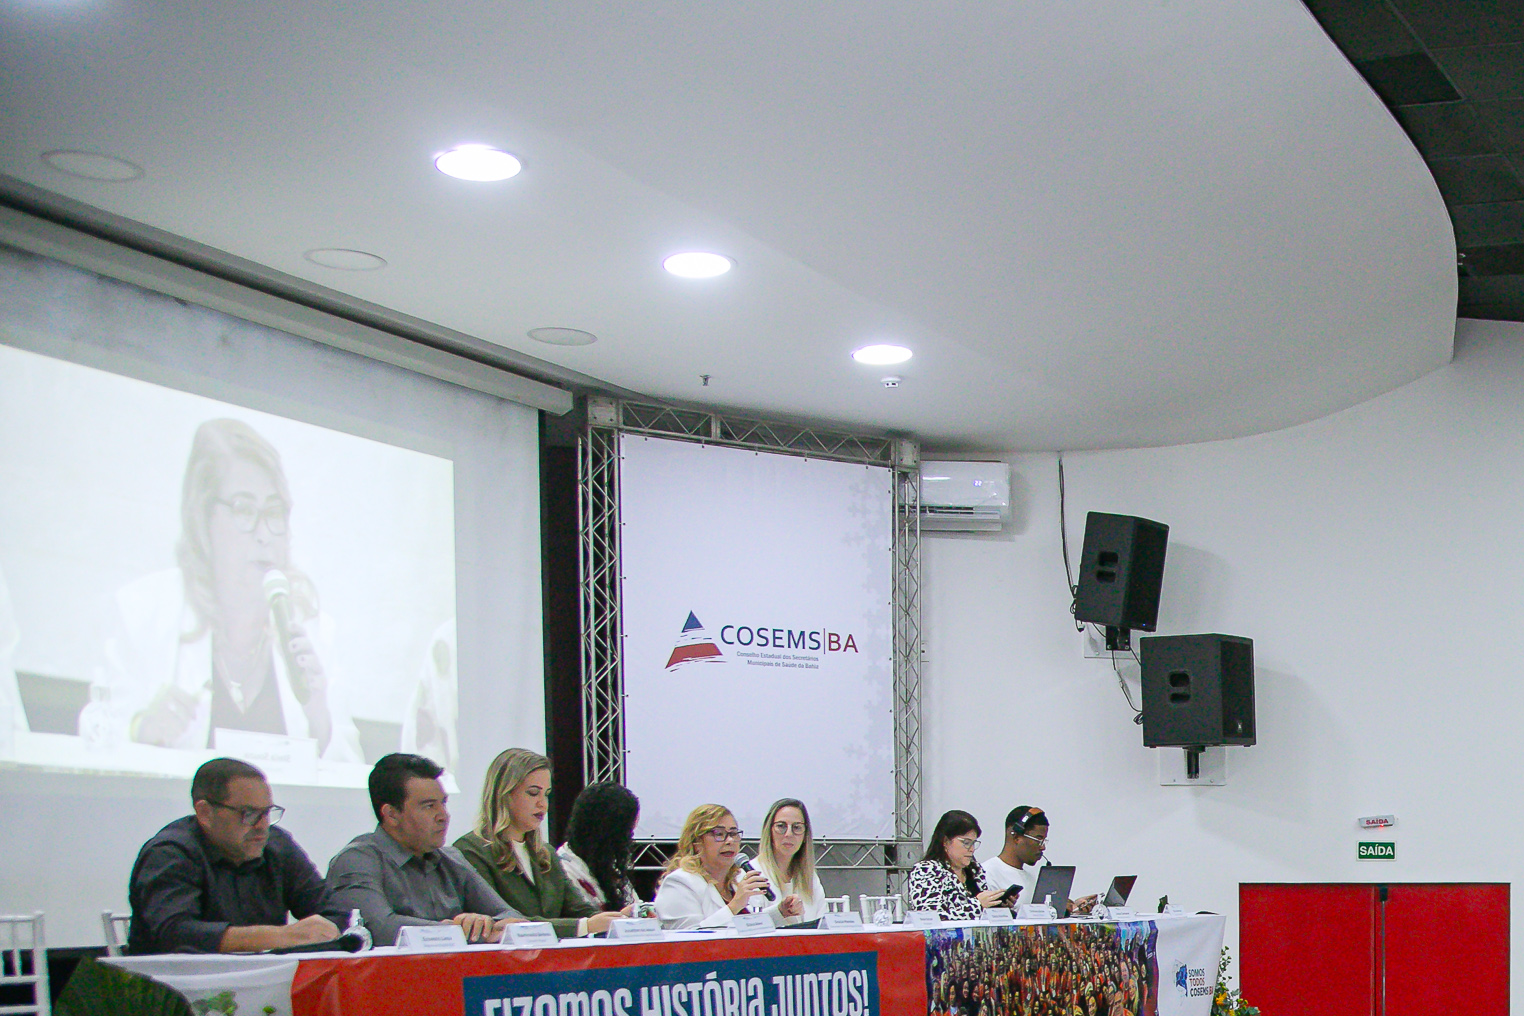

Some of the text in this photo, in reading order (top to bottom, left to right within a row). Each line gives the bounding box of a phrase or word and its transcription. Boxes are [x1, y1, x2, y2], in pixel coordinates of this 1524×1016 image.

[760, 652, 782, 660] Estadual
[1359, 843, 1394, 855] SAÍDA
[1188, 968, 1204, 977] SOMOS
[1189, 978, 1205, 987] TODOS
[1190, 987, 1209, 998] COSEMS
